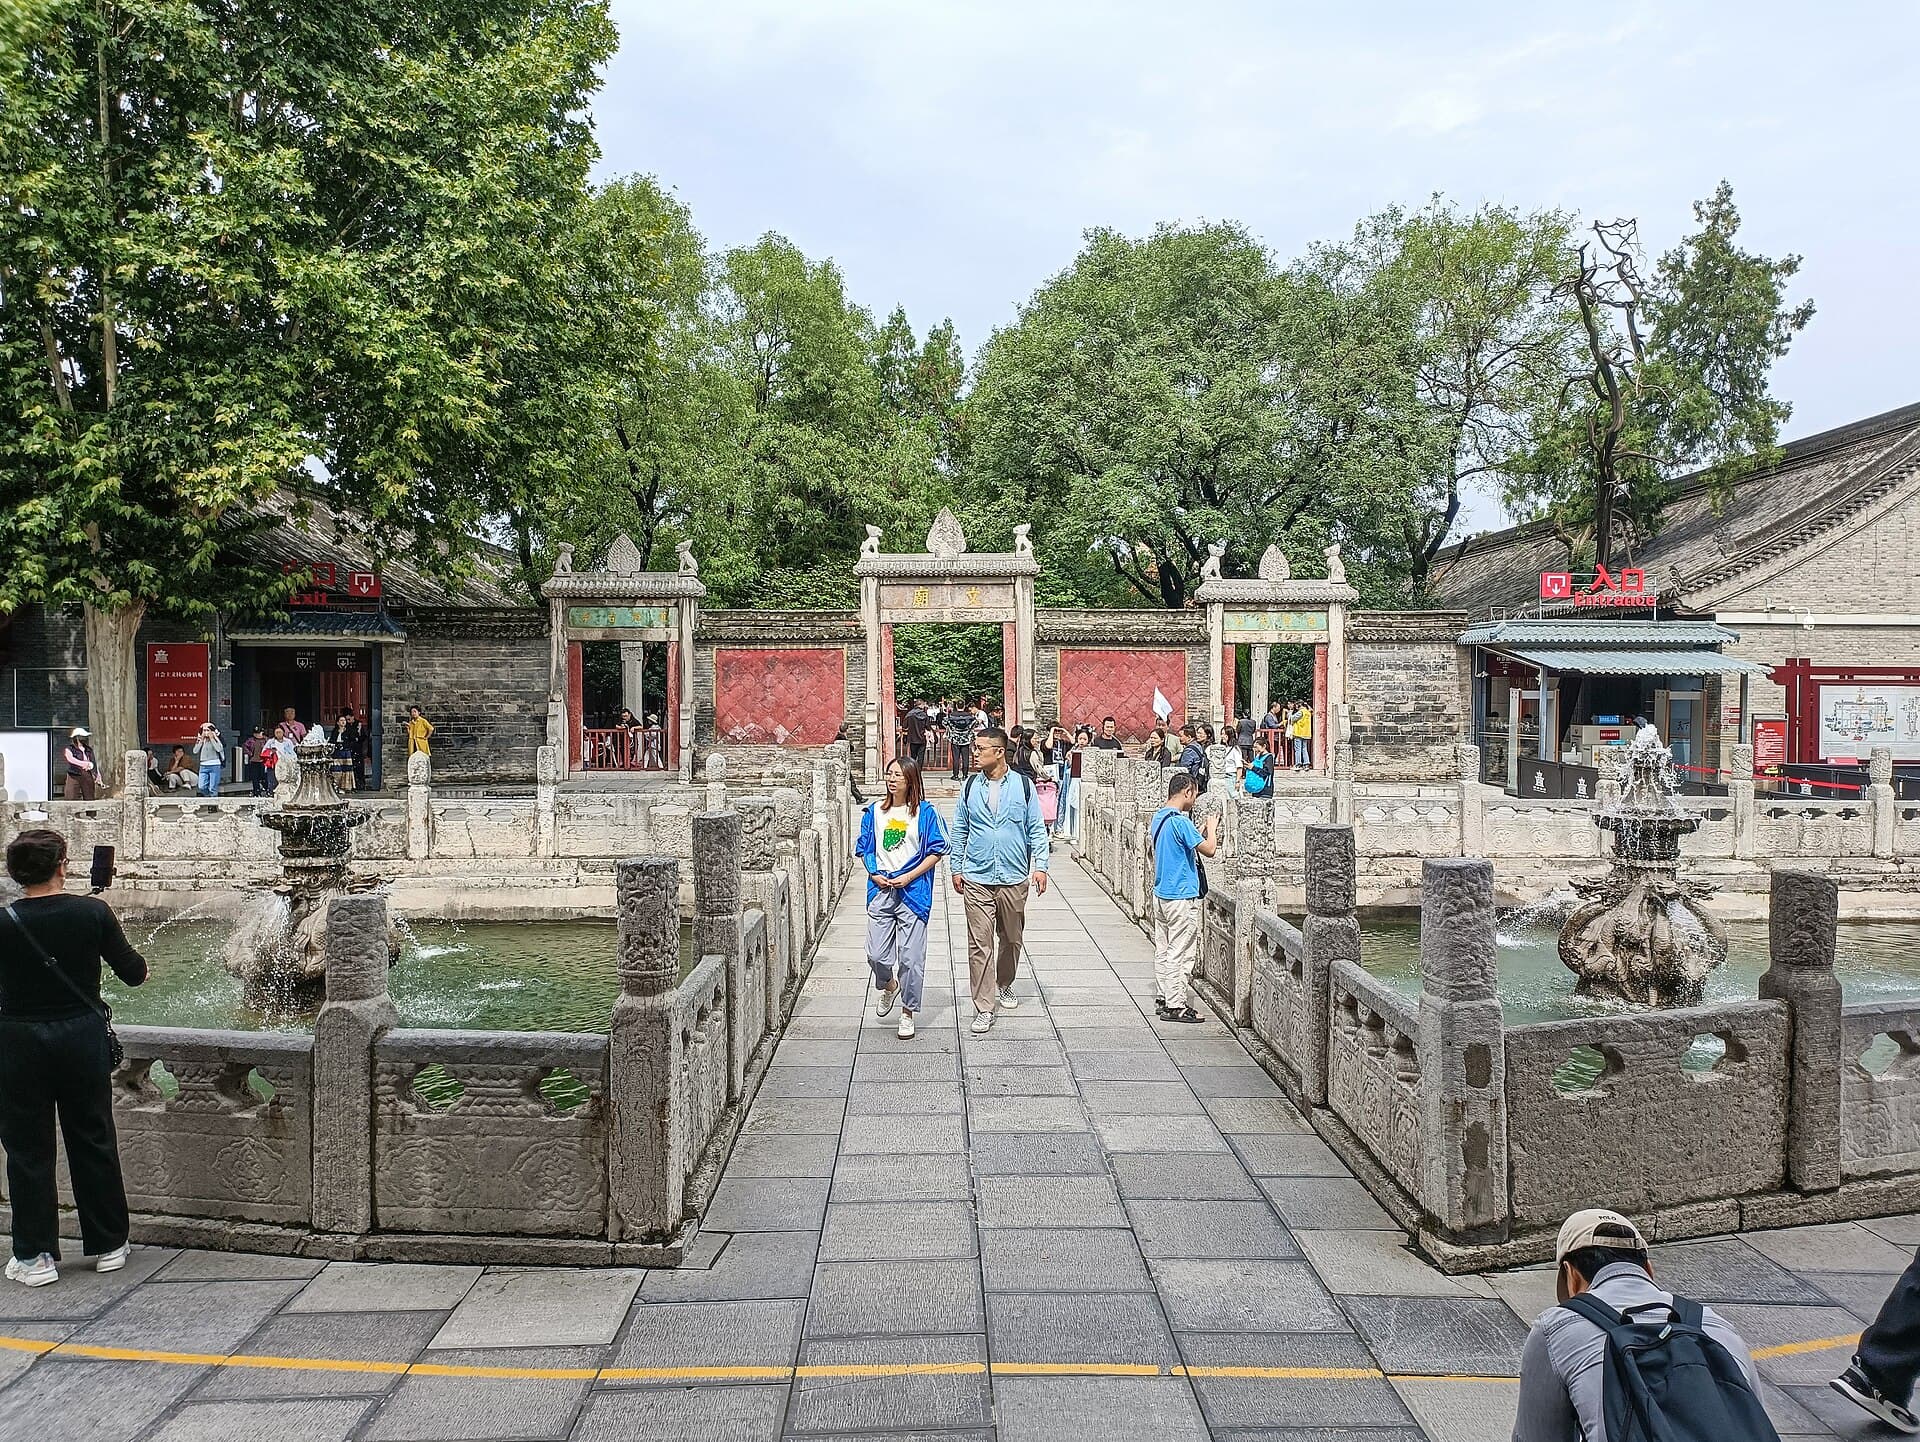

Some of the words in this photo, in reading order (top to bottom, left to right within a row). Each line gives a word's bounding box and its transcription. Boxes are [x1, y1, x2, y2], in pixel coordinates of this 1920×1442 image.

[1590, 563, 1645, 592] 入口
[290, 591, 327, 605] Exit
[1574, 592, 1657, 607] Entrance
